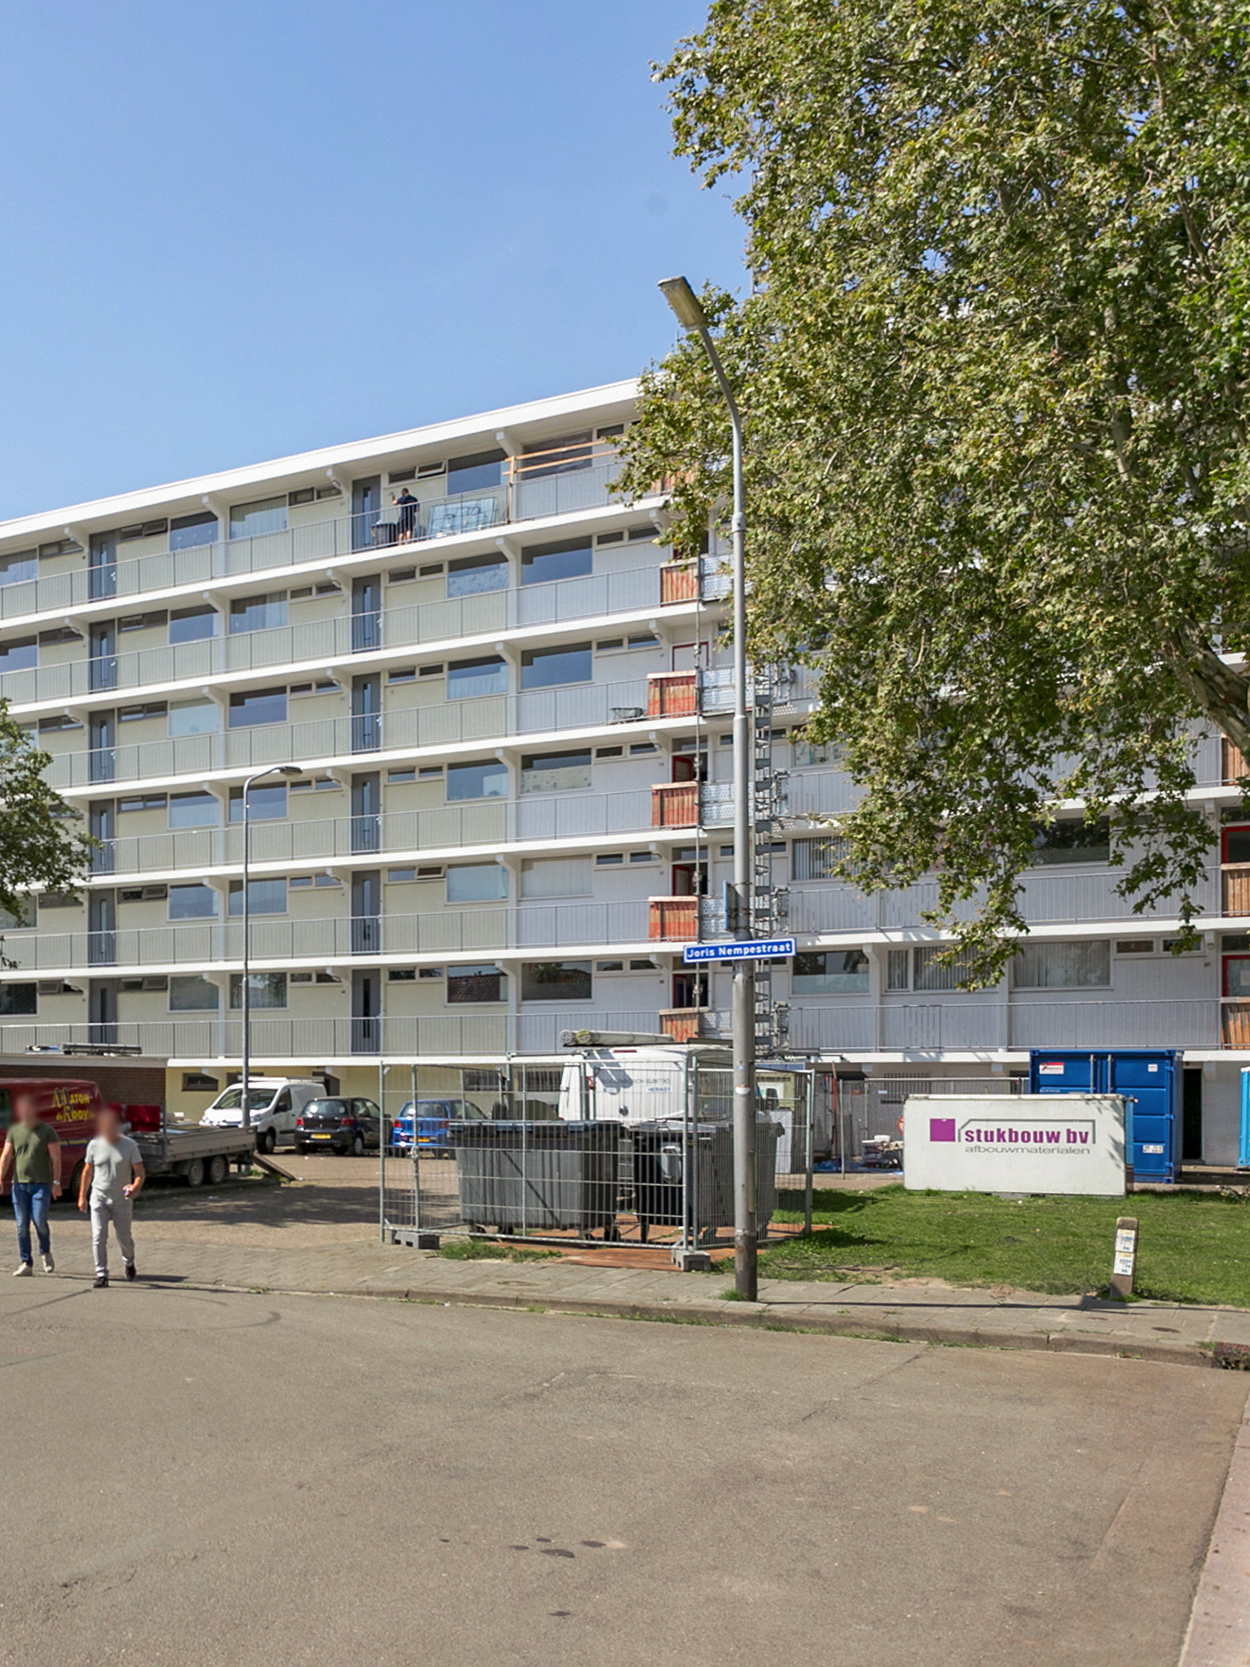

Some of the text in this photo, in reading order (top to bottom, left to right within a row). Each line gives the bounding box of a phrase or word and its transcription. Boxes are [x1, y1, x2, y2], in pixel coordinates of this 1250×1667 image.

[687, 942, 791, 958] Joris Nempestraat
[964, 1128, 1089, 1144] stukbouw bv
[964, 1145, 1091, 1155] afbouwmaterialen
